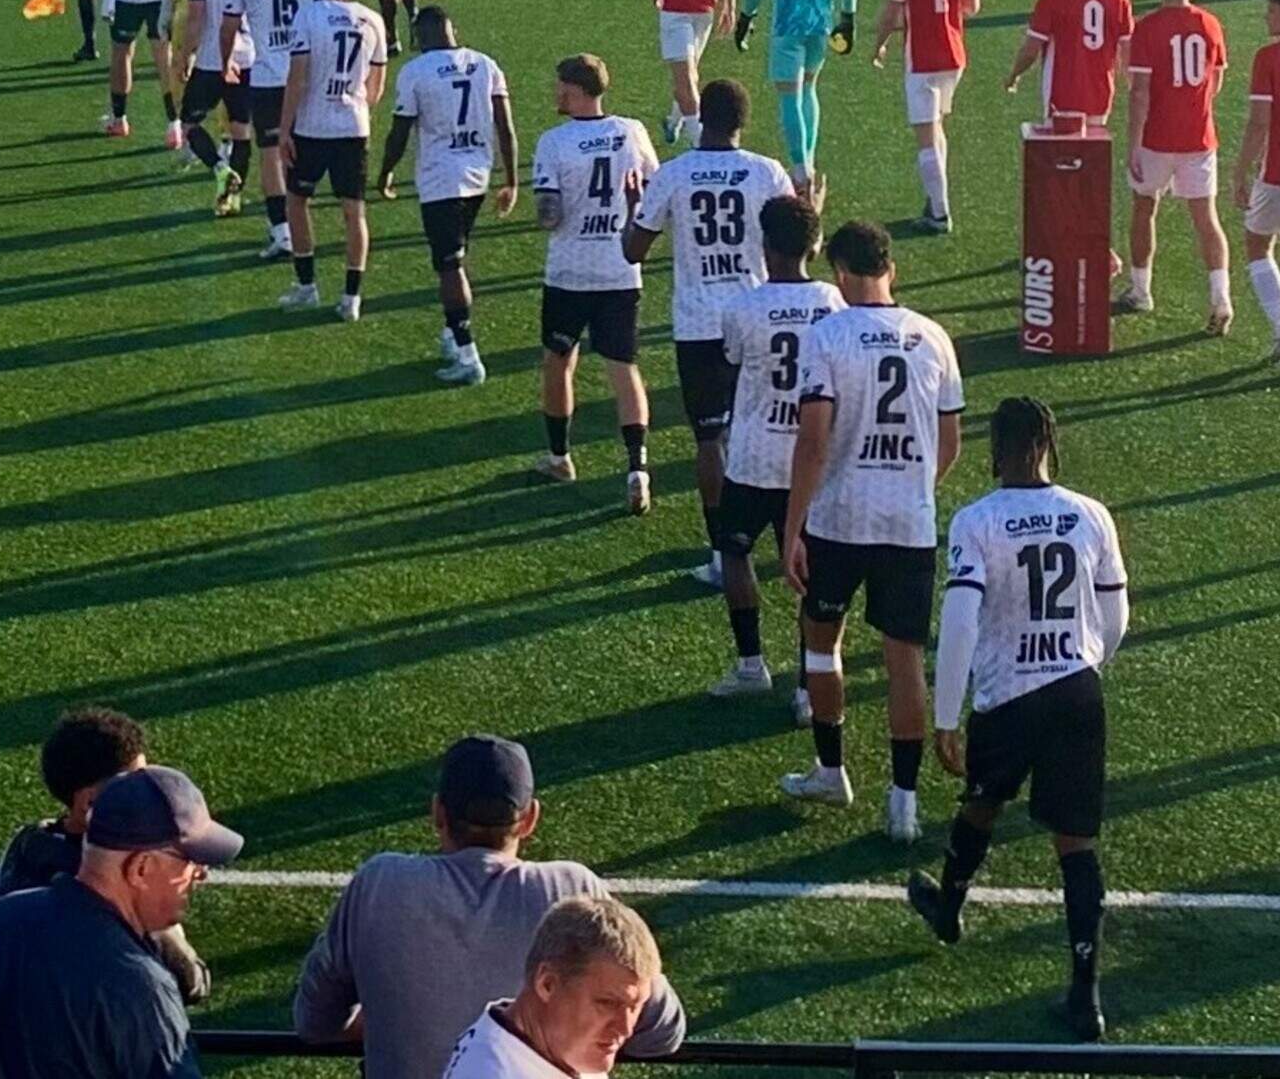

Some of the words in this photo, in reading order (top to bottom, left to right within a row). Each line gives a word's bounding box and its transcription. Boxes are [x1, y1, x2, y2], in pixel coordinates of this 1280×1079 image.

[333, 30, 363, 73] 17
[1170, 32, 1207, 88] 10
[452, 80, 471, 126] 7
[588, 157, 614, 208] 4
[690, 171, 728, 182] CARU
[690, 190, 745, 246] 33
[768, 308, 809, 321] CARU
[1024, 256, 1054, 327] OURS
[770, 331, 799, 391] 3
[859, 331, 900, 345] CARU
[876, 355, 908, 424] 2
[1005, 514, 1053, 532] CARU
[1016, 540, 1078, 622] 12
